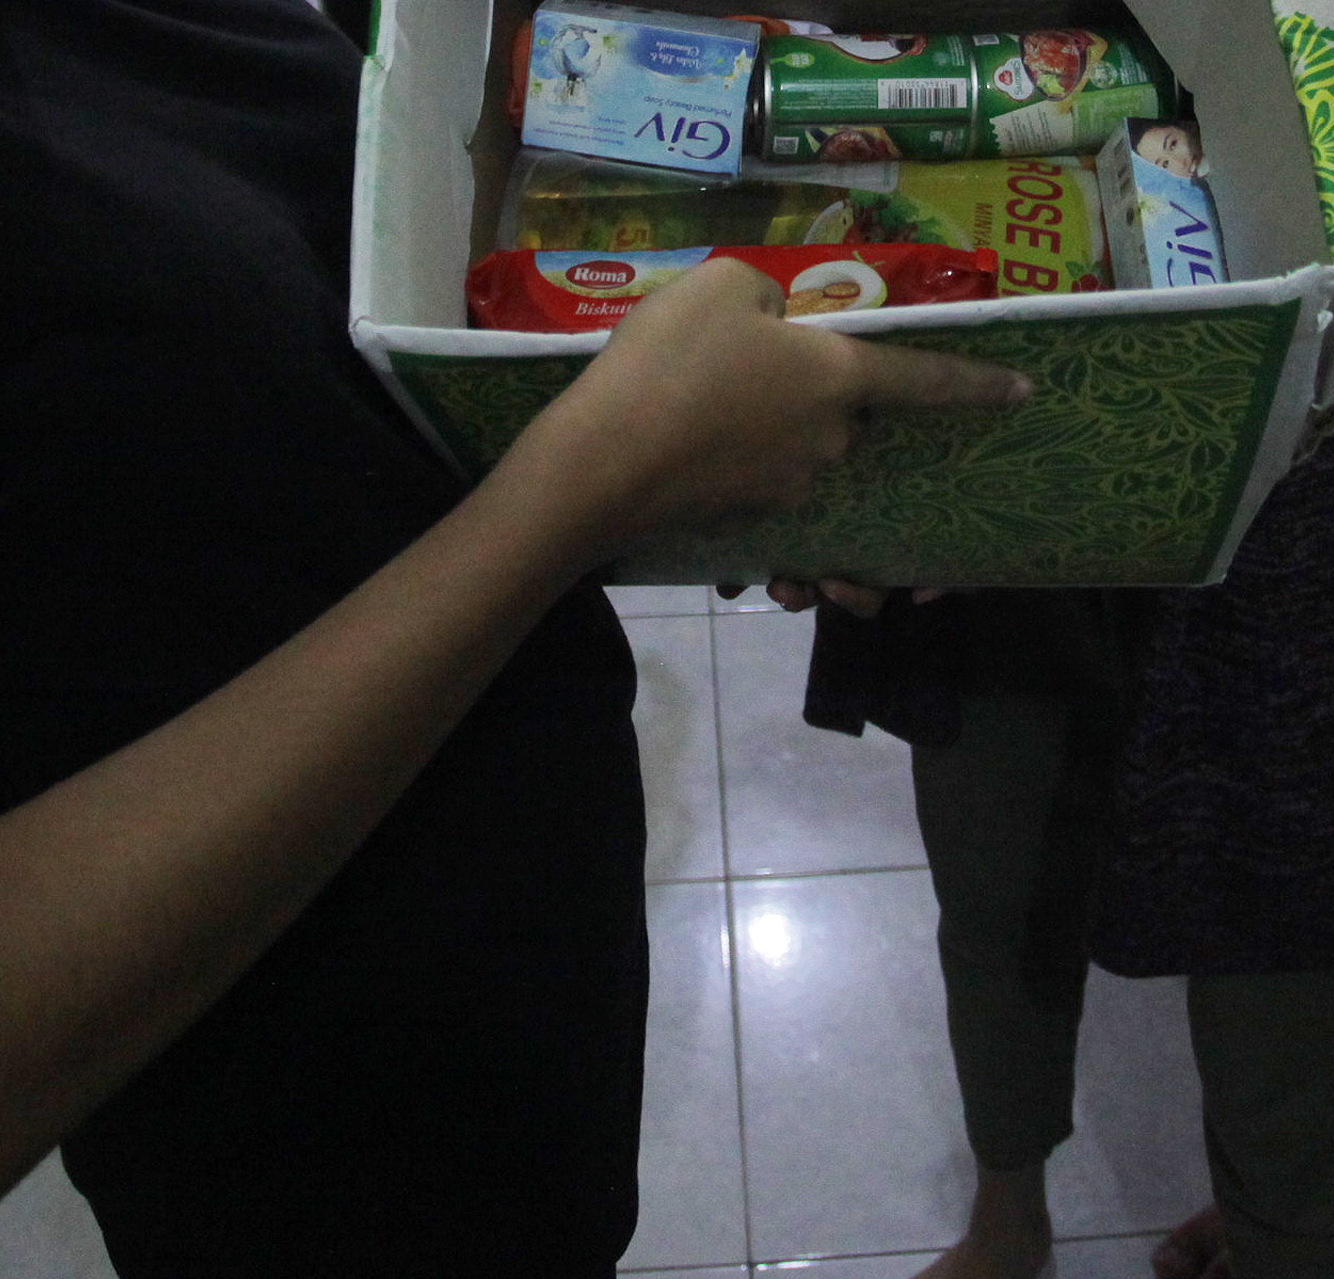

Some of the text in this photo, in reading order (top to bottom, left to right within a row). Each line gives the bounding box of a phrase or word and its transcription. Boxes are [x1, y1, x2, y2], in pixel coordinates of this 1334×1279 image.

[634, 113, 731, 161] Giv
[972, 203, 994, 252] MINYA
[1005, 160, 1063, 255] ROSE
[574, 267, 629, 284] Roma
